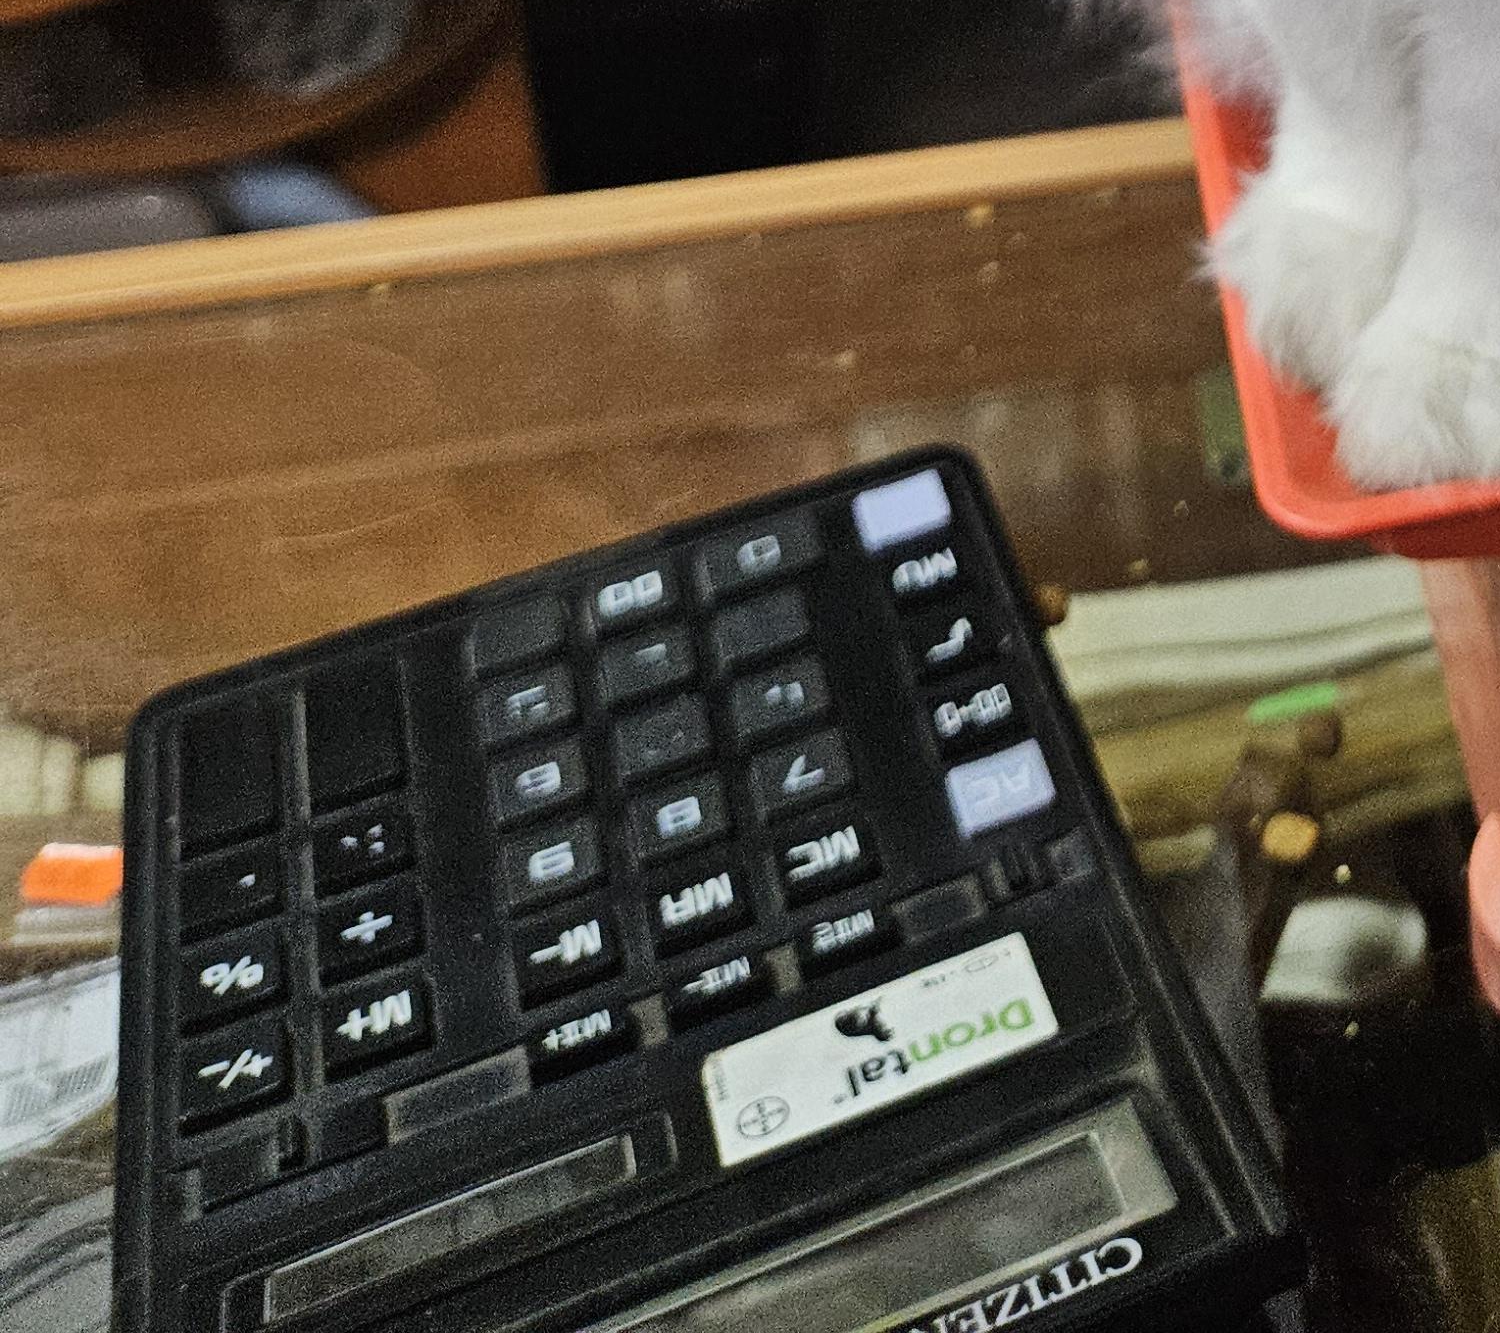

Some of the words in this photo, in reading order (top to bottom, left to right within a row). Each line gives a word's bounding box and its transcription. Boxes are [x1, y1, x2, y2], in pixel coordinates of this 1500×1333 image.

[786, 824, 861, 880] MC
[660, 872, 734, 928] MR
[843, 996, 1036, 1098] Drontal
